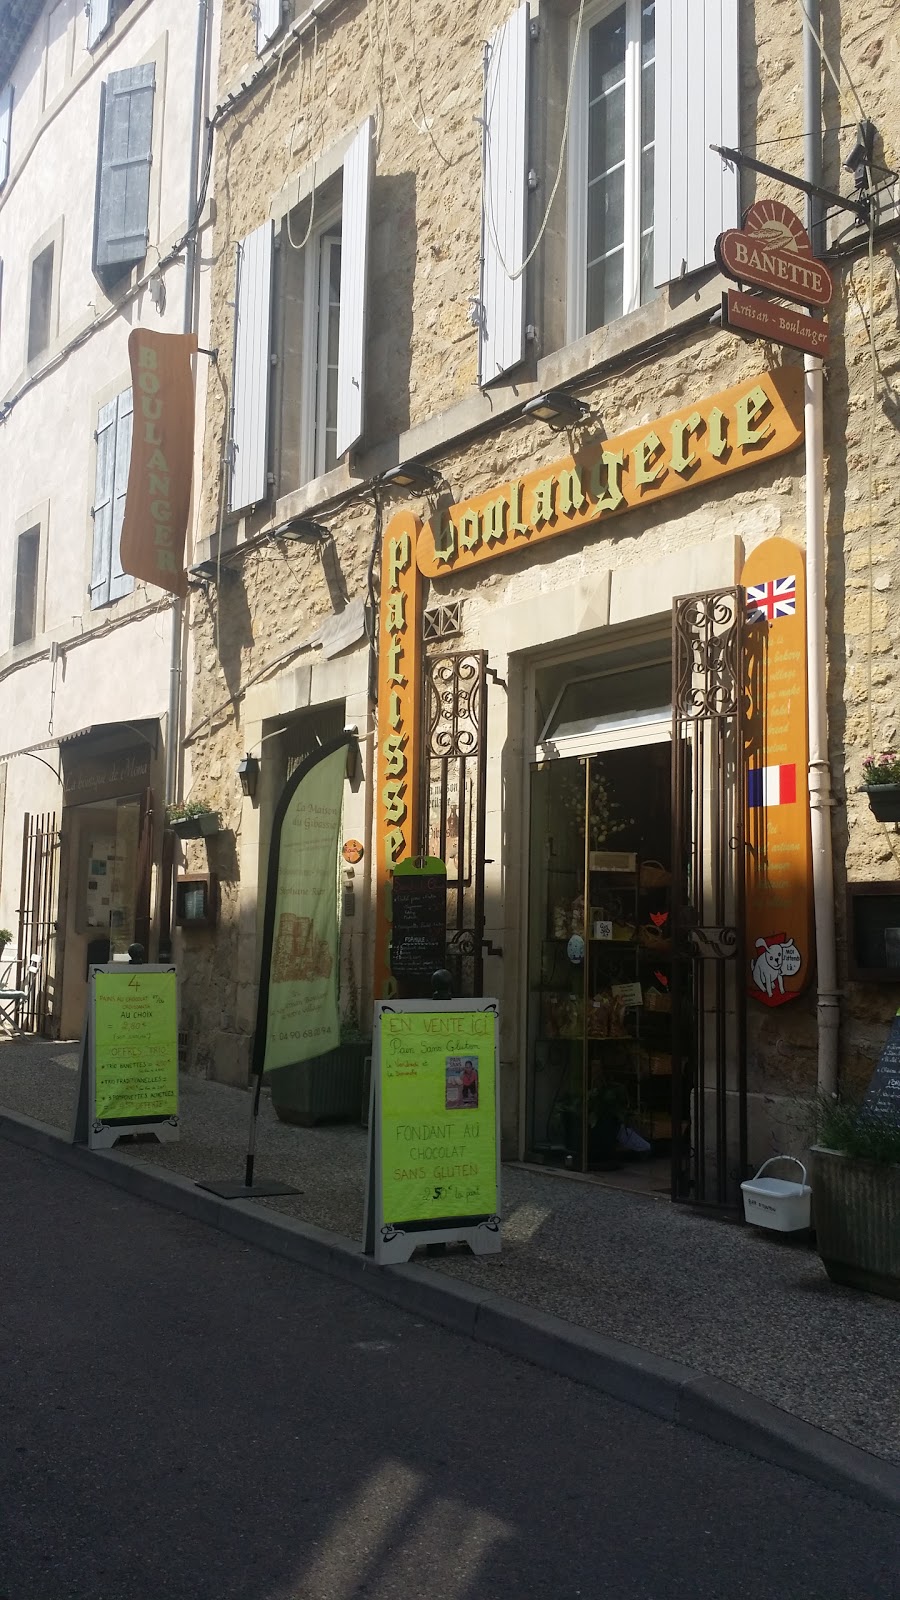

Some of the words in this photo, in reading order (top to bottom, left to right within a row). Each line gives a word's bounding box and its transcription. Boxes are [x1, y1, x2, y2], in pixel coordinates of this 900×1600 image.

[734, 241, 823, 292] BANETTE
[731, 302, 769, 322] Artisan
[779, 317, 828, 345] Boulanger
[138, 345, 178, 574] BOULANGER
[127, 974, 141, 992] 4
[120, 1011, 131, 1019] AU
[133, 1010, 153, 1019] CHOIX
[389, 1017, 412, 1033] EN
[423, 1017, 465, 1033] VENTE
[290, 1030, 301, 1040] 90
[302, 1029, 313, 1039] 68
[389, 1037, 416, 1056] Pain
[420, 1040, 443, 1054] Sans
[396, 1123, 455, 1141] FONDANT
[463, 1122, 480, 1139] AU
[409, 1145, 467, 1161] CHOCOLAT
[393, 1166, 426, 1181] SANS
[433, 1163, 480, 1180] GLUTEN
